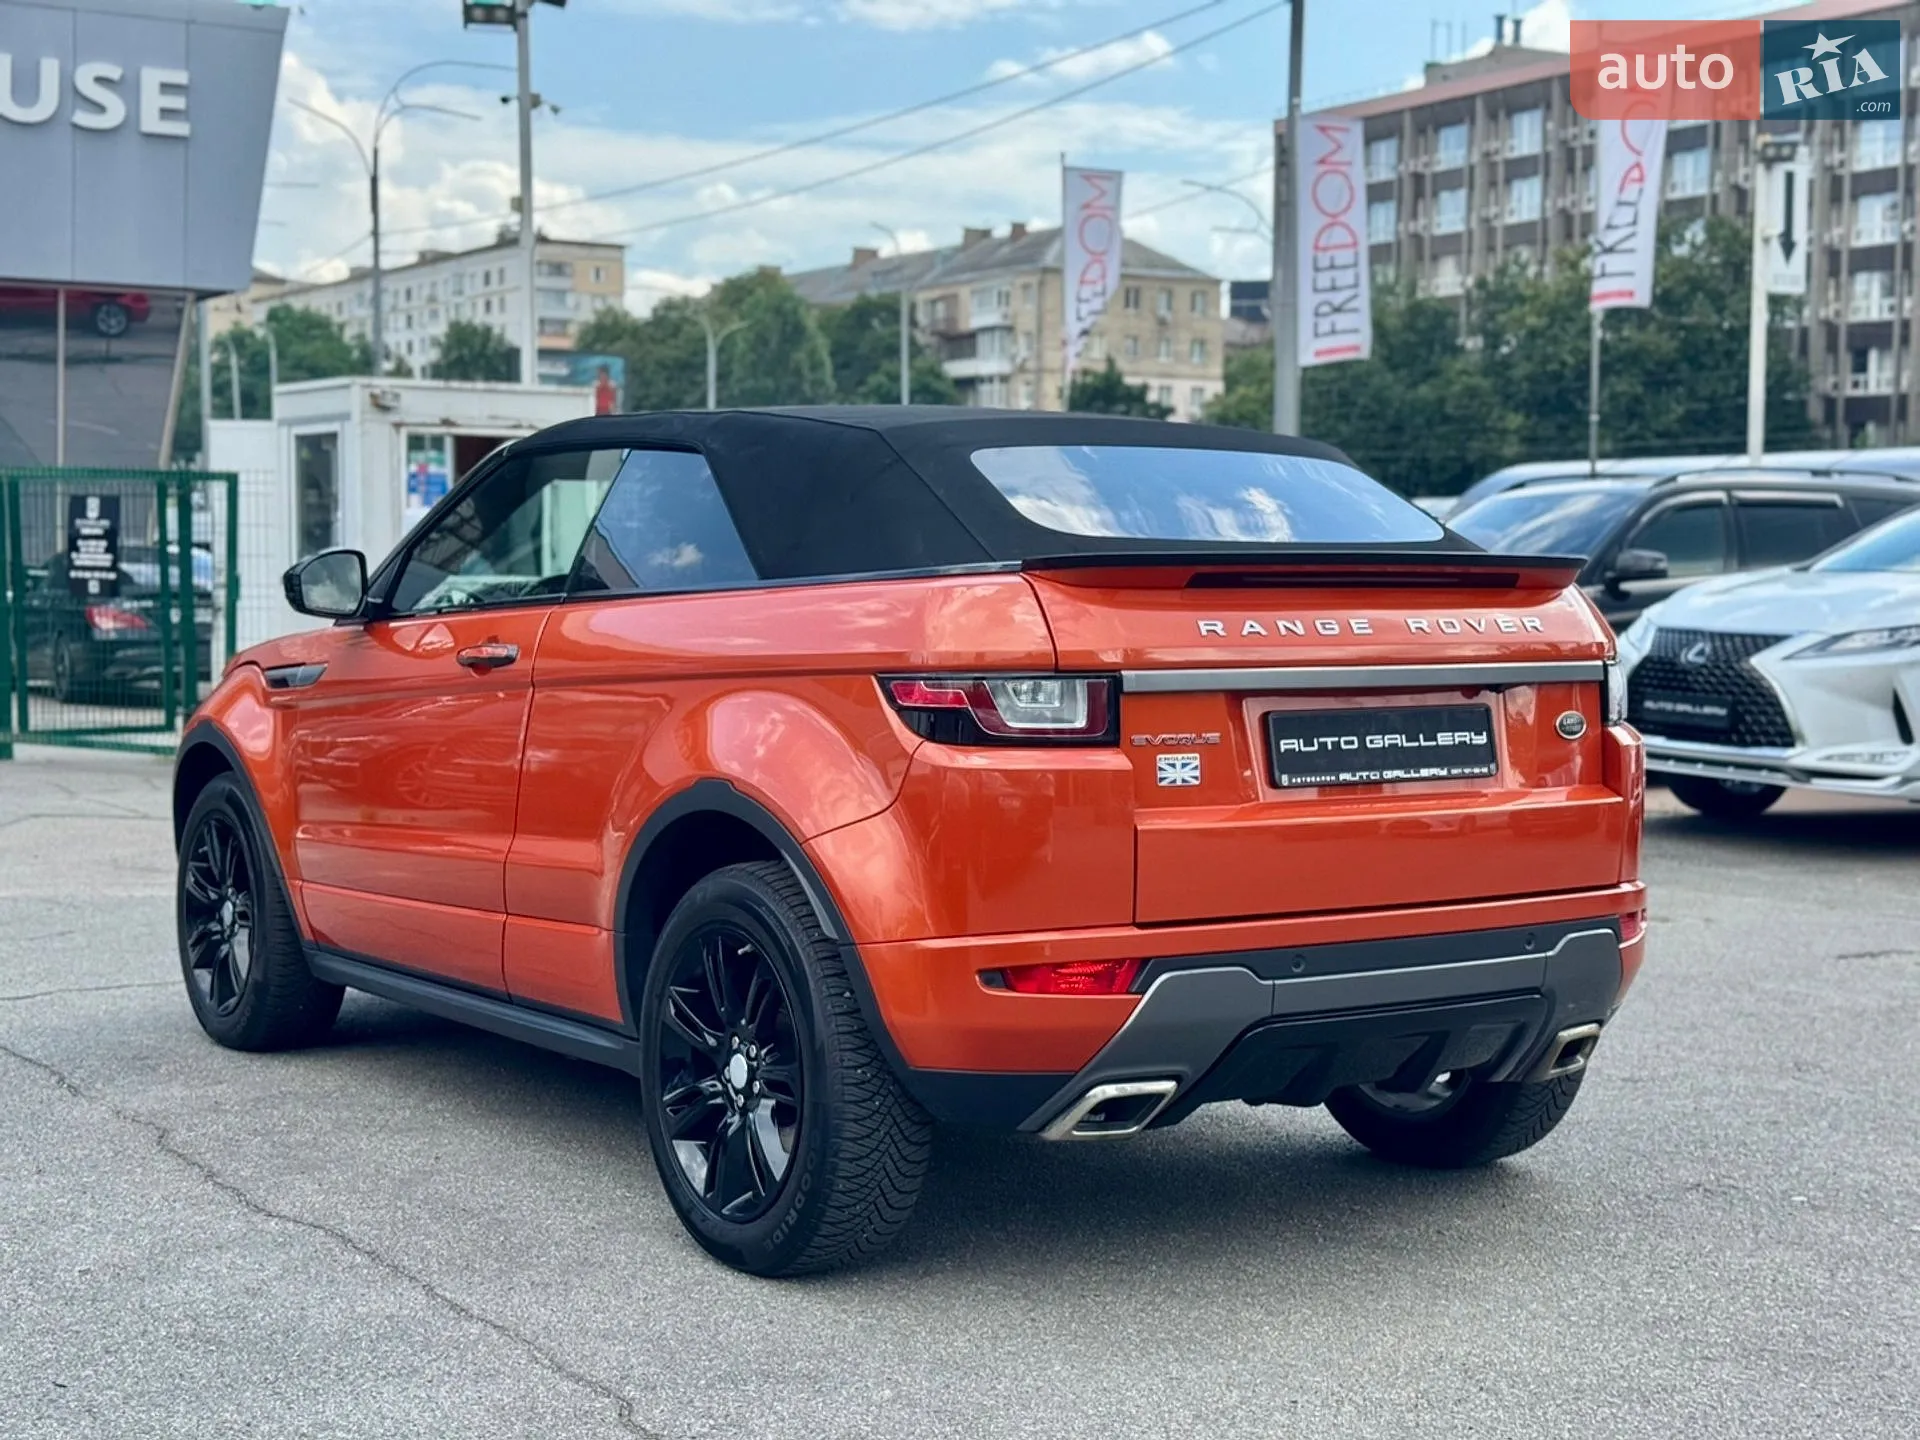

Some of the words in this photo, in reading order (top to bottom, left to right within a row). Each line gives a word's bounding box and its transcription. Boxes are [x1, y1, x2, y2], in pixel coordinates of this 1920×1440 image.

[0, 53, 191, 137] USE
[1196, 618, 1374, 637] RANGE
[1403, 616, 1545, 635] ROVER
[1131, 732, 1222, 746] EVOQUE
[1279, 737, 1358, 753] AUTO
[1366, 731, 1487, 749] GALLERY
[1339, 771, 1380, 781] AUTO
[1382, 768, 1448, 779] GALLERY
